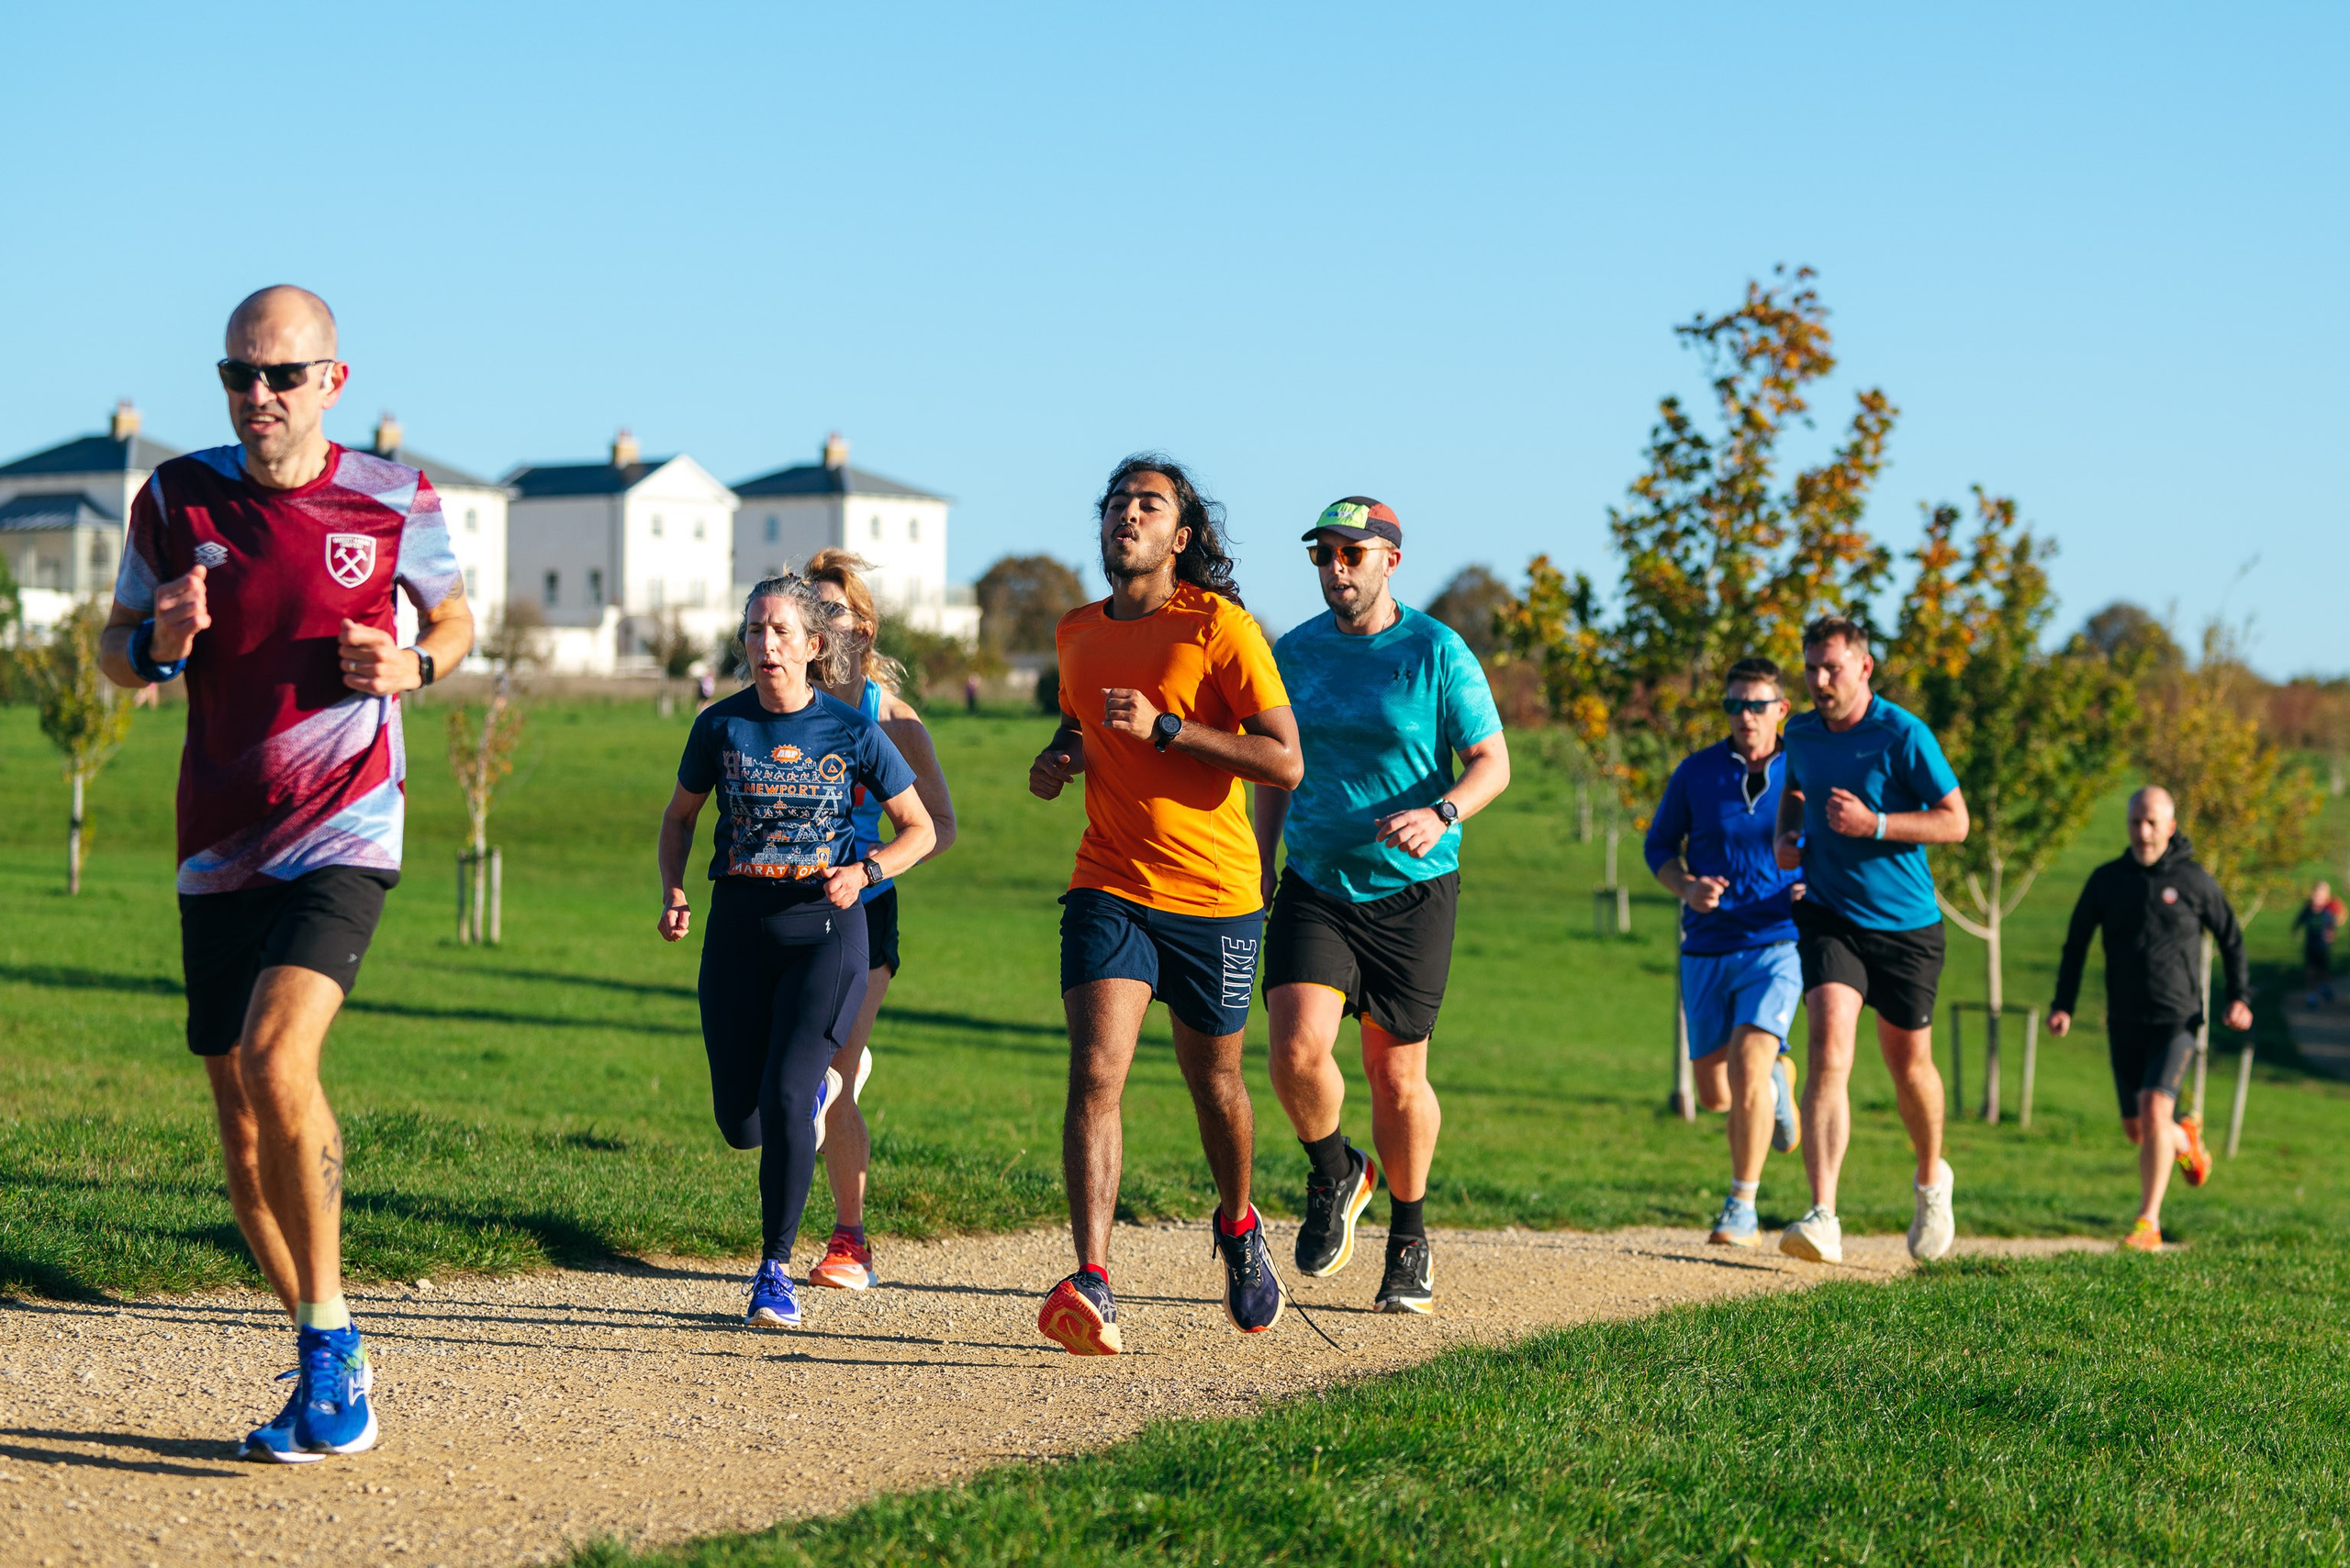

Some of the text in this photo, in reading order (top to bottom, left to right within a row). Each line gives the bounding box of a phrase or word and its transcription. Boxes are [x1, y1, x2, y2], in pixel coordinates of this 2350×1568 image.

[744, 782, 820, 796] NEWPORT
[732, 863, 821, 877] MARATHON
[1222, 935, 1258, 1008] NIKE
